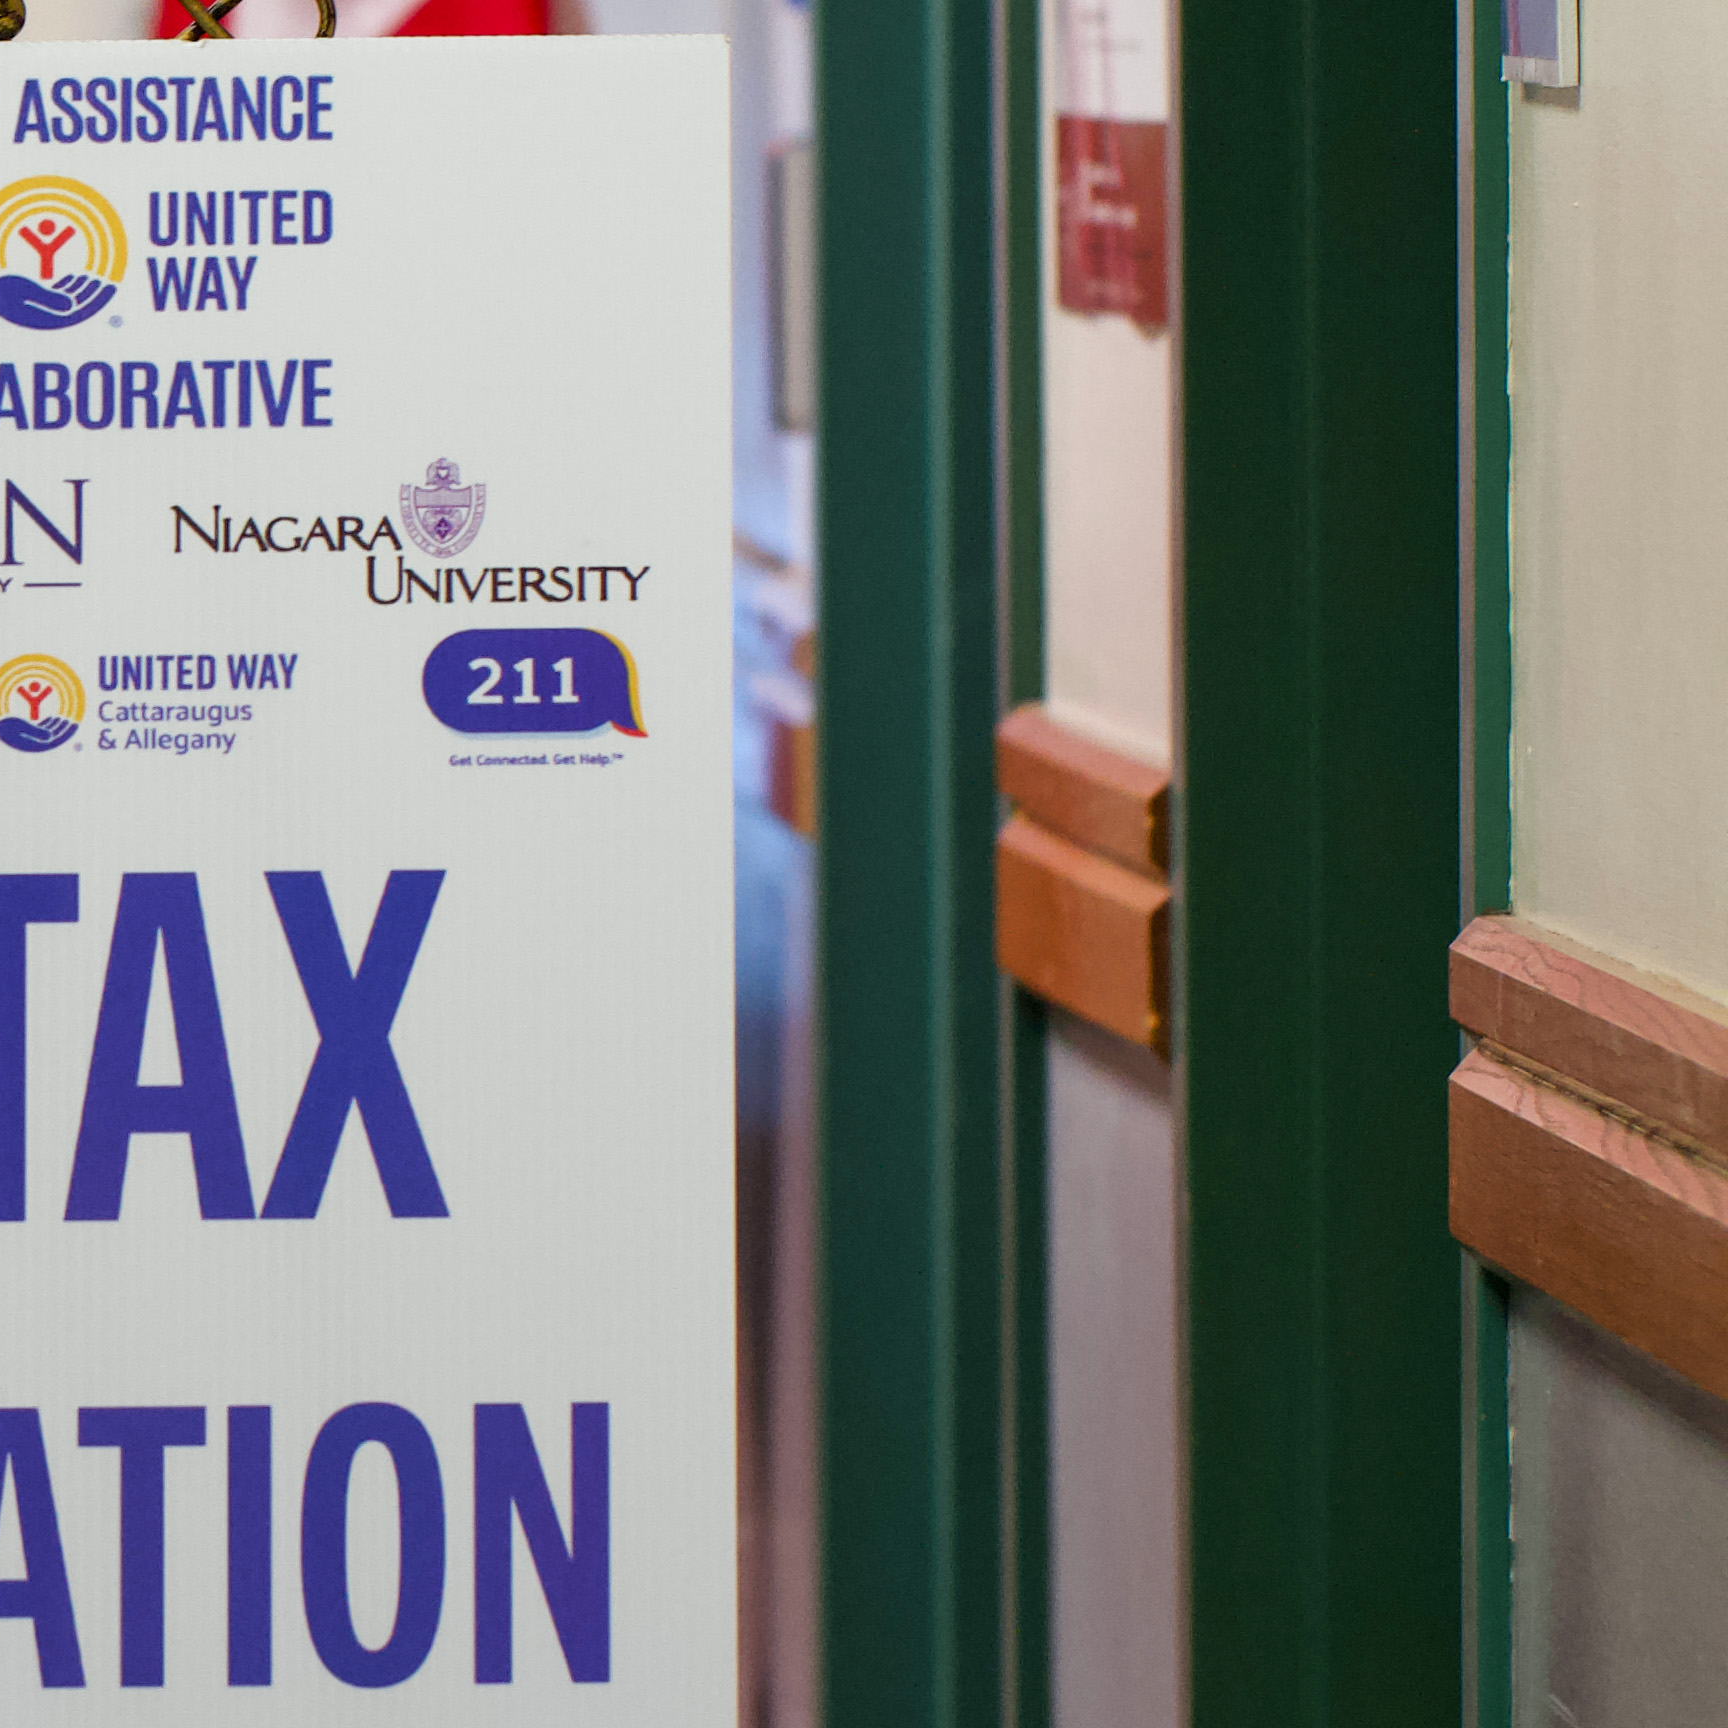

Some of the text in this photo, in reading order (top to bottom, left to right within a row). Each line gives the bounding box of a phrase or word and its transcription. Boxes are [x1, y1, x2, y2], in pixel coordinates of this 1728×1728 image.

[12, 74, 334, 145] ASSISTANCE
[148, 189, 334, 248] UNITED
[146, 255, 259, 313] WAY
[169, 504, 404, 554] NIAGARA
[365, 555, 651, 606] UNIVERSITY
[98, 653, 299, 692] UNITED WAY
[468, 657, 579, 704] 211
[97, 700, 253, 728] Cattaraugus
[97, 727, 237, 756] & Allegany
[448, 754, 473, 767] Get
[552, 753, 577, 766] Get
